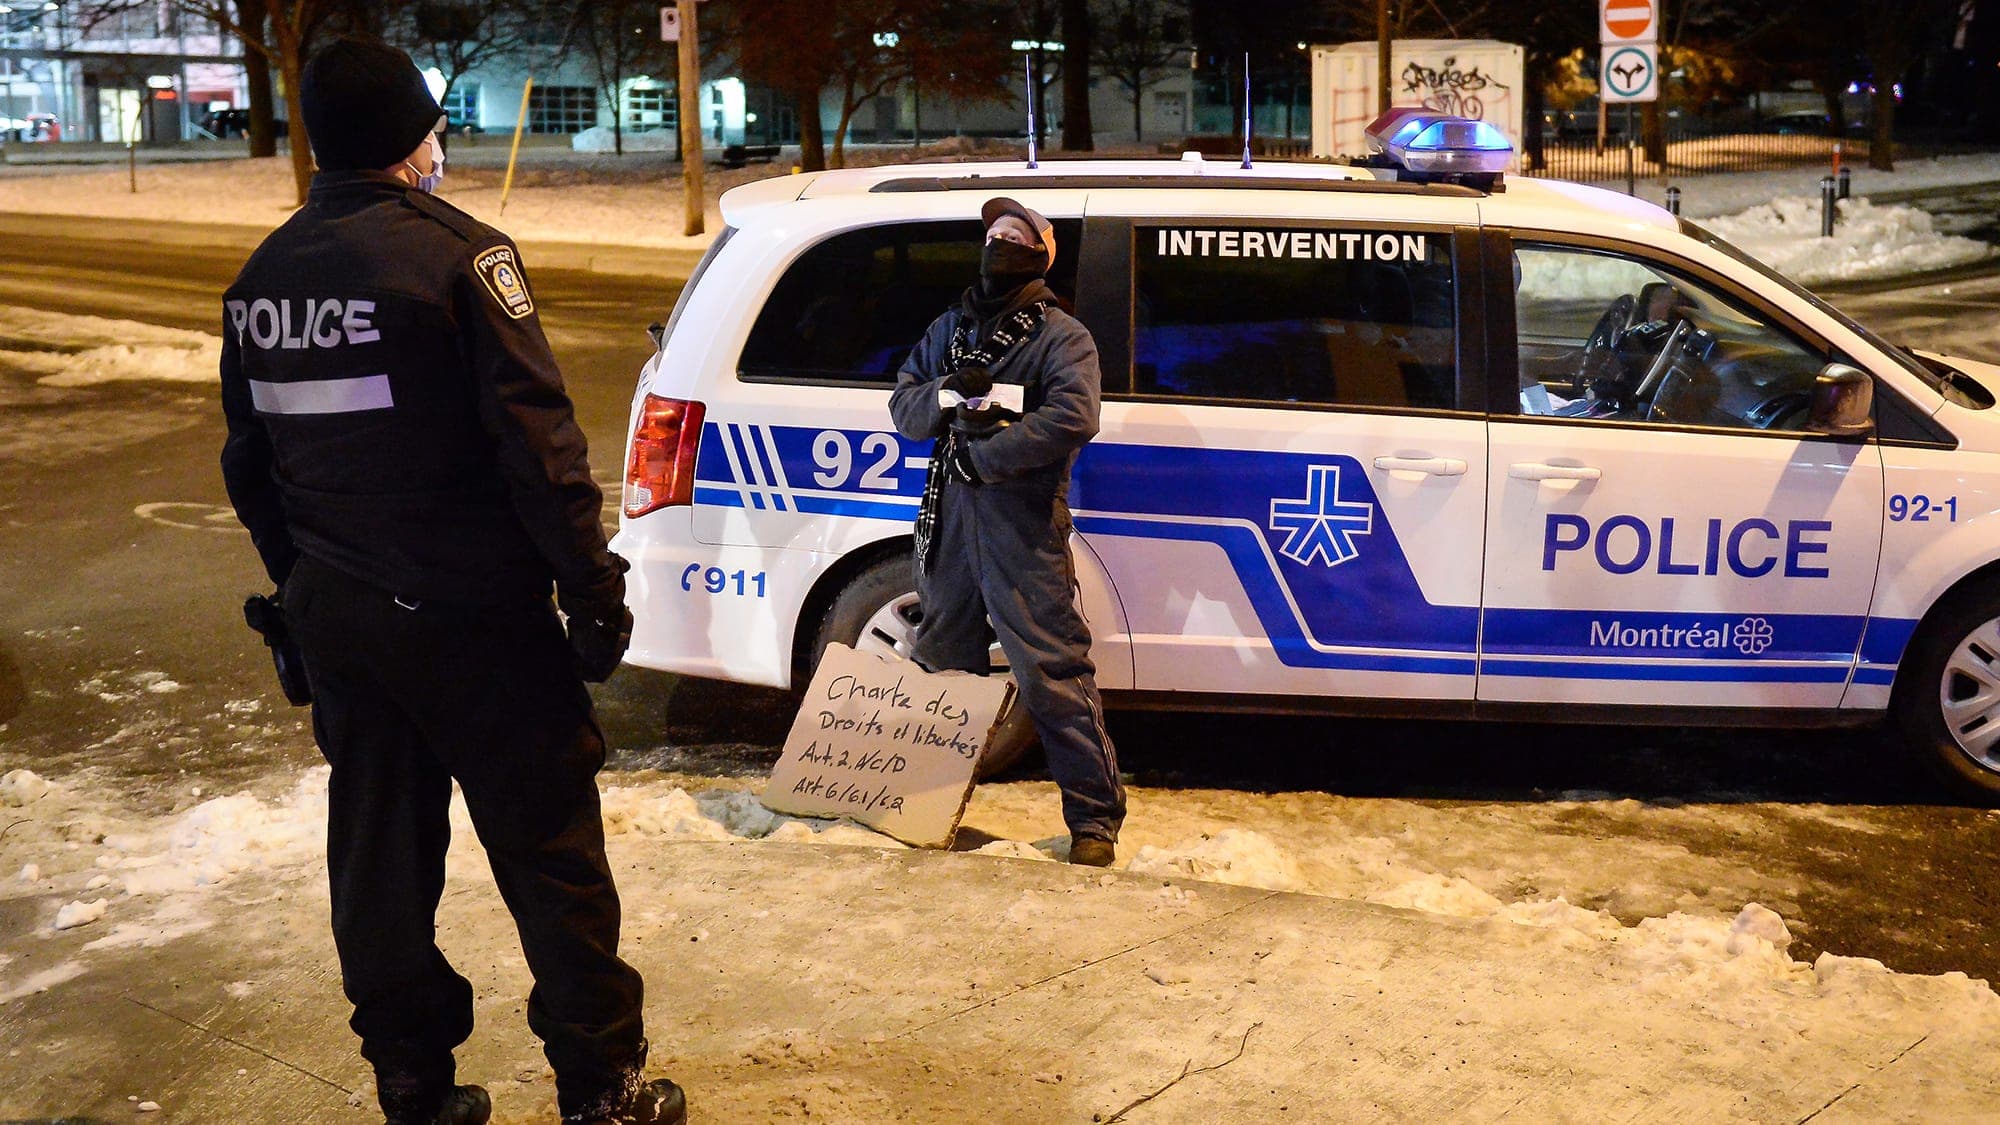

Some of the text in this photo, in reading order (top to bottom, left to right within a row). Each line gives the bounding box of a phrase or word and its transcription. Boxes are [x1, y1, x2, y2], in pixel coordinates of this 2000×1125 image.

[1158, 230, 1425, 261] INTERVENTION
[479, 251, 511, 272] POLICE
[226, 298, 380, 349] POLICE
[1889, 495, 1958, 522] 92-1
[1541, 513, 1832, 578] POLICE
[704, 567, 766, 598] 911
[1590, 620, 1729, 649] Montréal
[828, 675, 968, 726] Charte des
[819, 709, 883, 736] Droits
[912, 724, 979, 759] libertés
